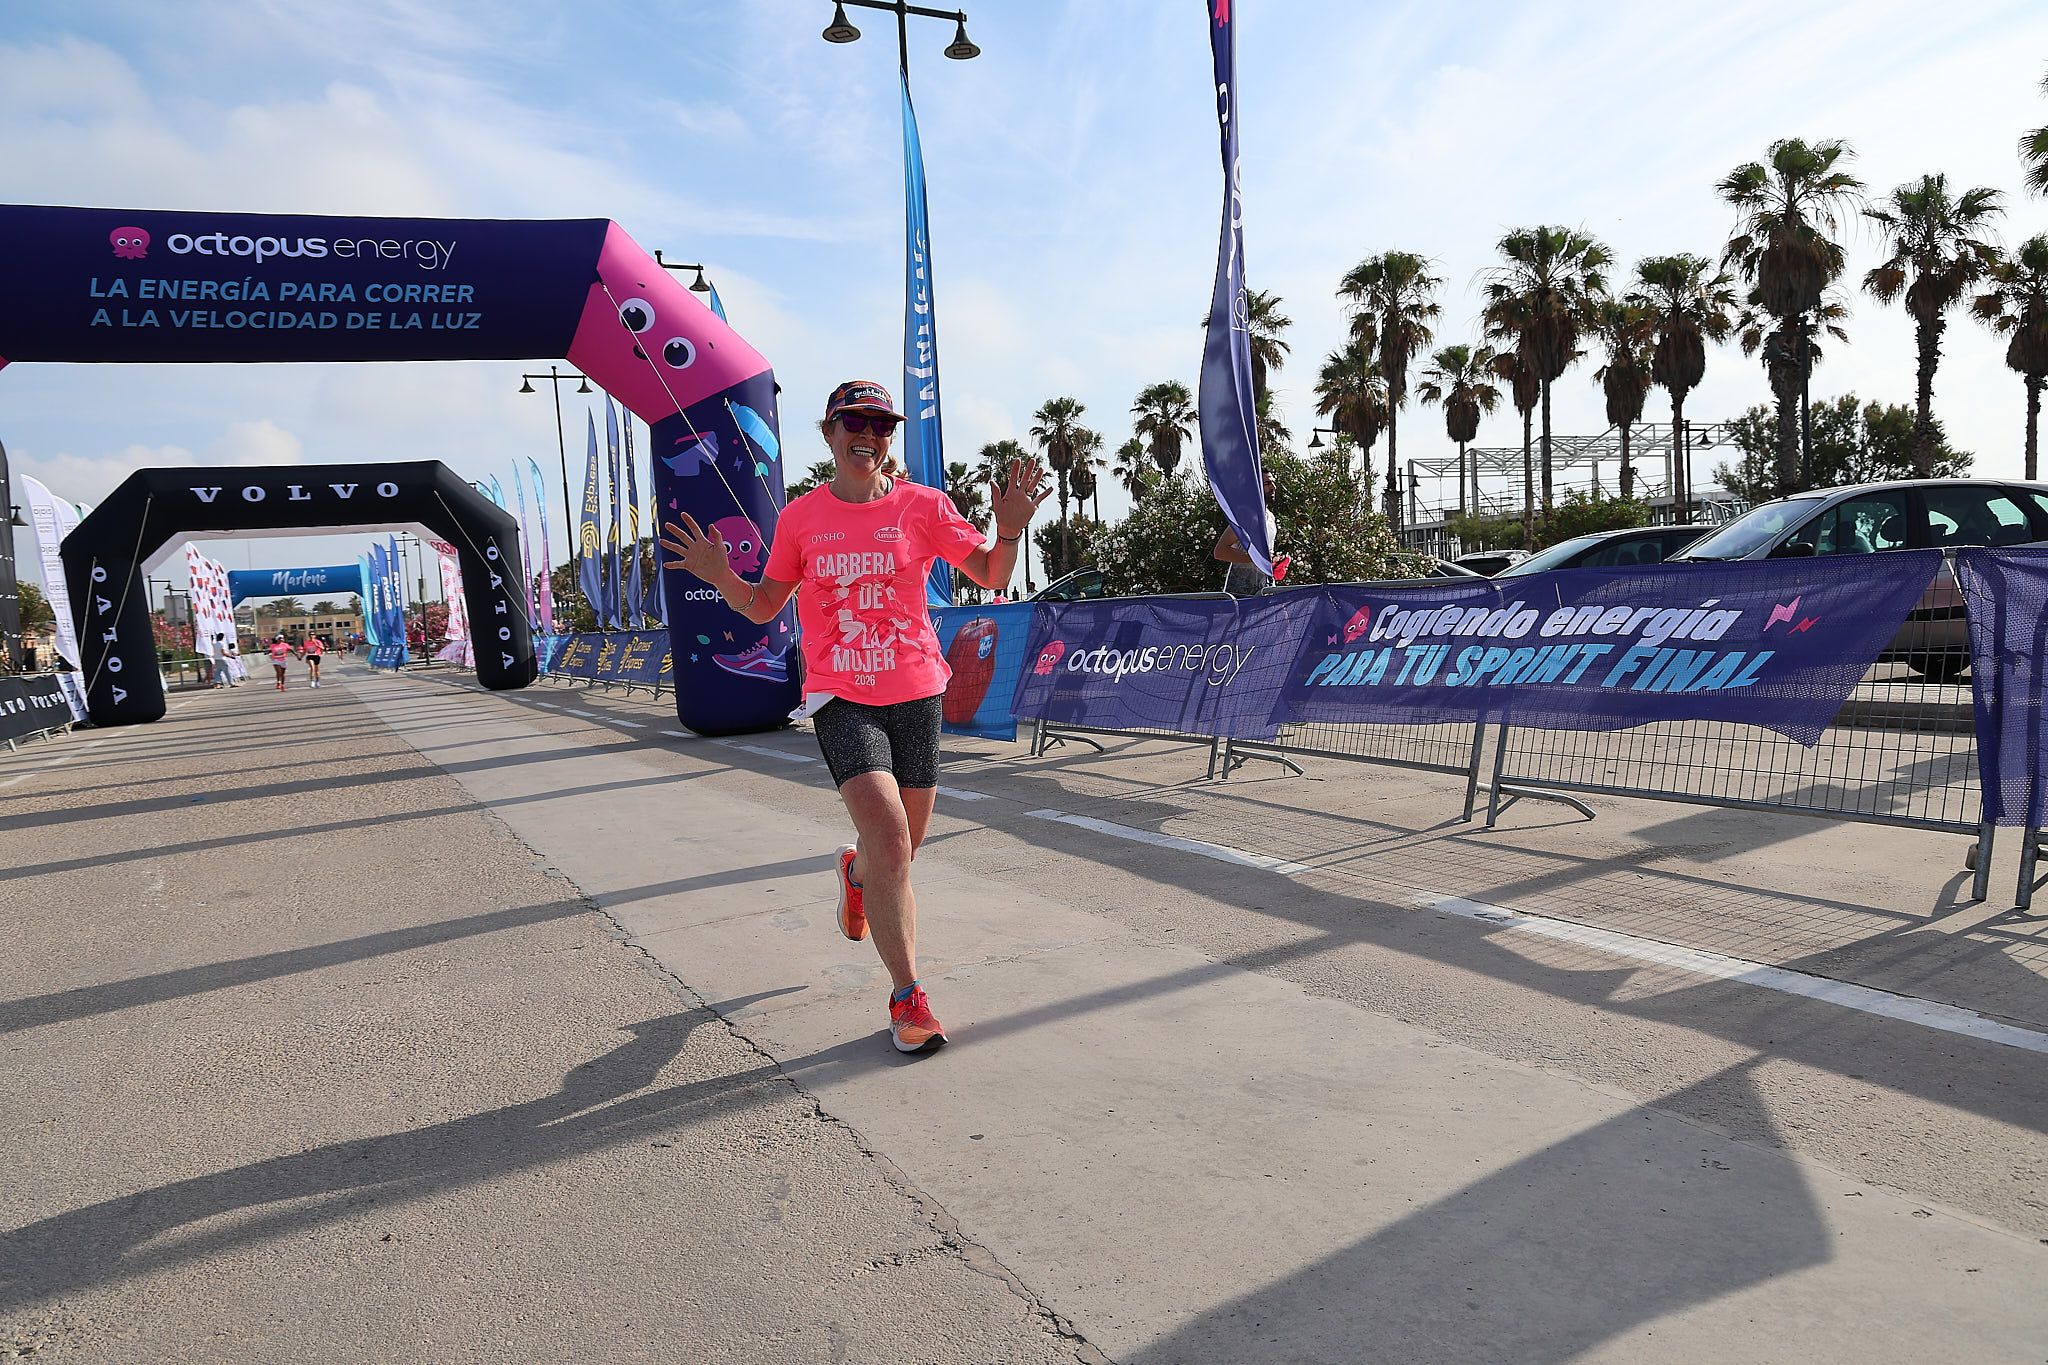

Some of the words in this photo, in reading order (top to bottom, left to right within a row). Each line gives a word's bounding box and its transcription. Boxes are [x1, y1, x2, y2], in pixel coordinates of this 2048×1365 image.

[166, 231, 328, 263] octopus
[333, 238, 456, 270] energy
[89, 277, 129, 298] LA
[138, 276, 270, 301] ENERGÍA
[279, 283, 354, 302] PARA
[364, 284, 474, 303] CORRER
[90, 308, 113, 327] A
[121, 309, 160, 328] LA
[168, 309, 337, 329] VELOCIDAD
[345, 312, 382, 329] DE
[390, 312, 423, 329] LA
[431, 313, 482, 330] LUZ
[189, 482, 399, 503] VOLVO
[811, 531, 845, 544] OYSHO
[816, 552, 896, 577] CARRERA
[272, 569, 328, 593] Marlene
[487, 546, 515, 669] VOLVO
[684, 588, 724, 602] octop
[858, 584, 884, 609] DE
[92, 567, 128, 705] VOLVO
[862, 624, 881, 649] LA
[1369, 601, 1540, 648] Cogiendo
[1540, 600, 1743, 646] energía
[833, 648, 896, 672] MUJER
[1067, 645, 1158, 683] octopus
[1156, 645, 1256, 686] energy
[1304, 647, 1392, 687] PARA
[1393, 645, 1450, 687] TU
[1445, 644, 1613, 687] SPRINT
[1602, 645, 1775, 693] FINAL
[854, 674, 876, 686] 2026
[0, 697, 26, 716] LVO
[29, 691, 66, 708] VOLVO
